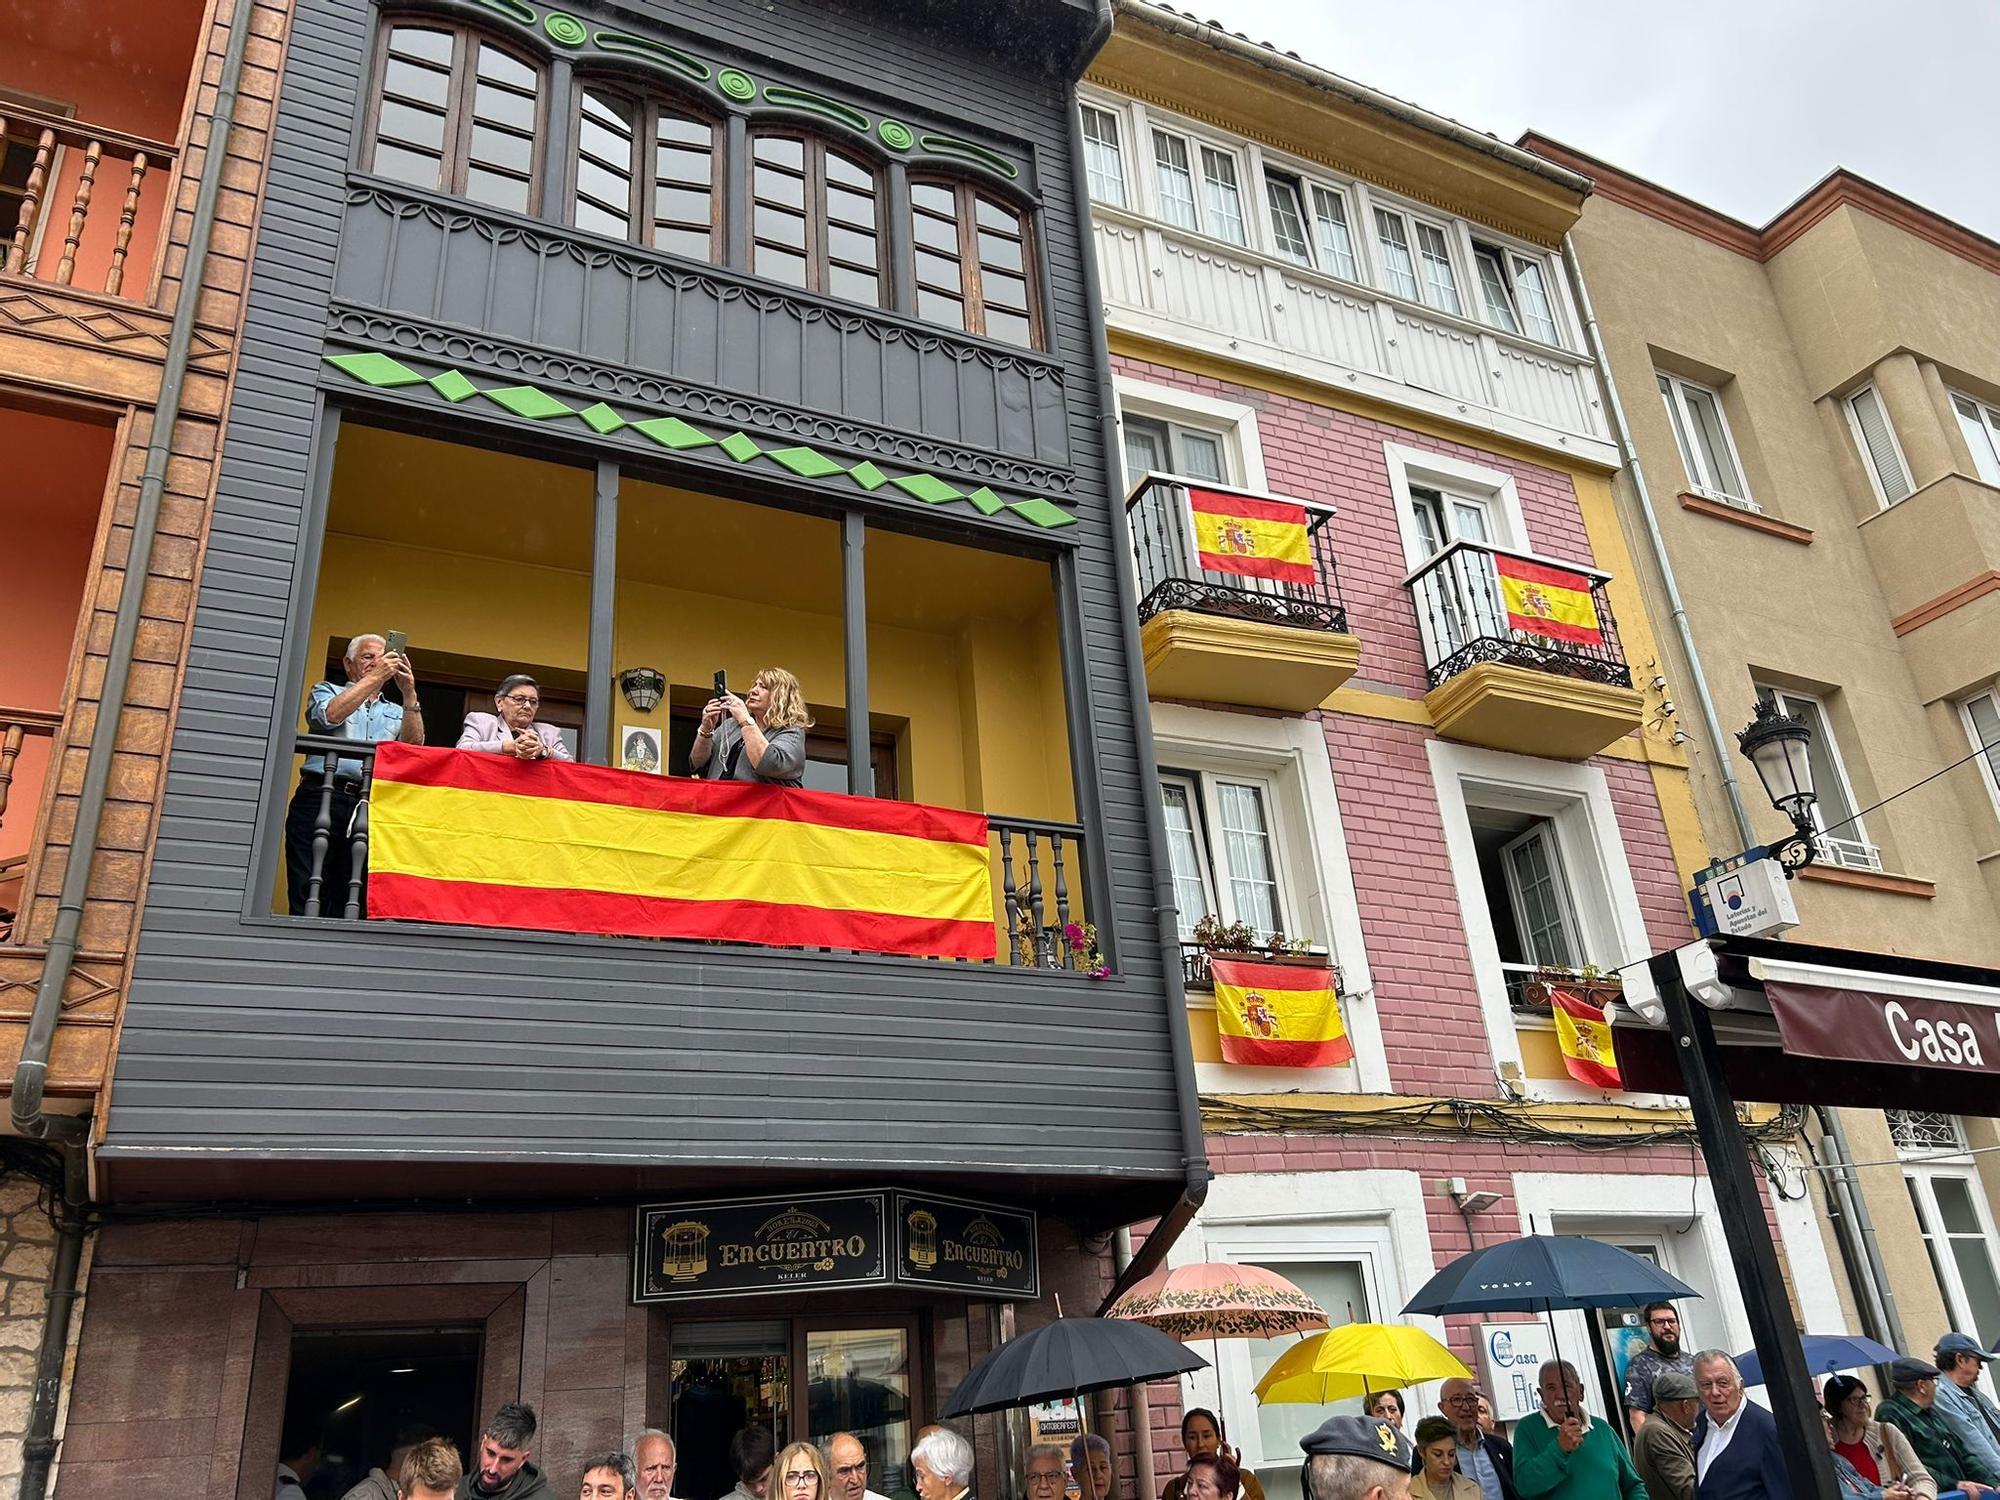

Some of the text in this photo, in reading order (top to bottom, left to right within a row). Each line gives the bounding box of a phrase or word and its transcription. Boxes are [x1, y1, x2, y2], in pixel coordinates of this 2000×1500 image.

[1729, 908, 1768, 927] Apuestas del
[1730, 922, 1752, 934] Estado
[1884, 1001, 1985, 1067] Casa
[719, 1234, 866, 1267] ENCUENTRO
[942, 1239, 1023, 1270] ENCUENTRO
[1480, 1281, 1533, 1290] VOLVO
[1488, 1330, 1539, 1368] Casa
[1040, 1420, 1077, 1431] OKTOBERFEST
